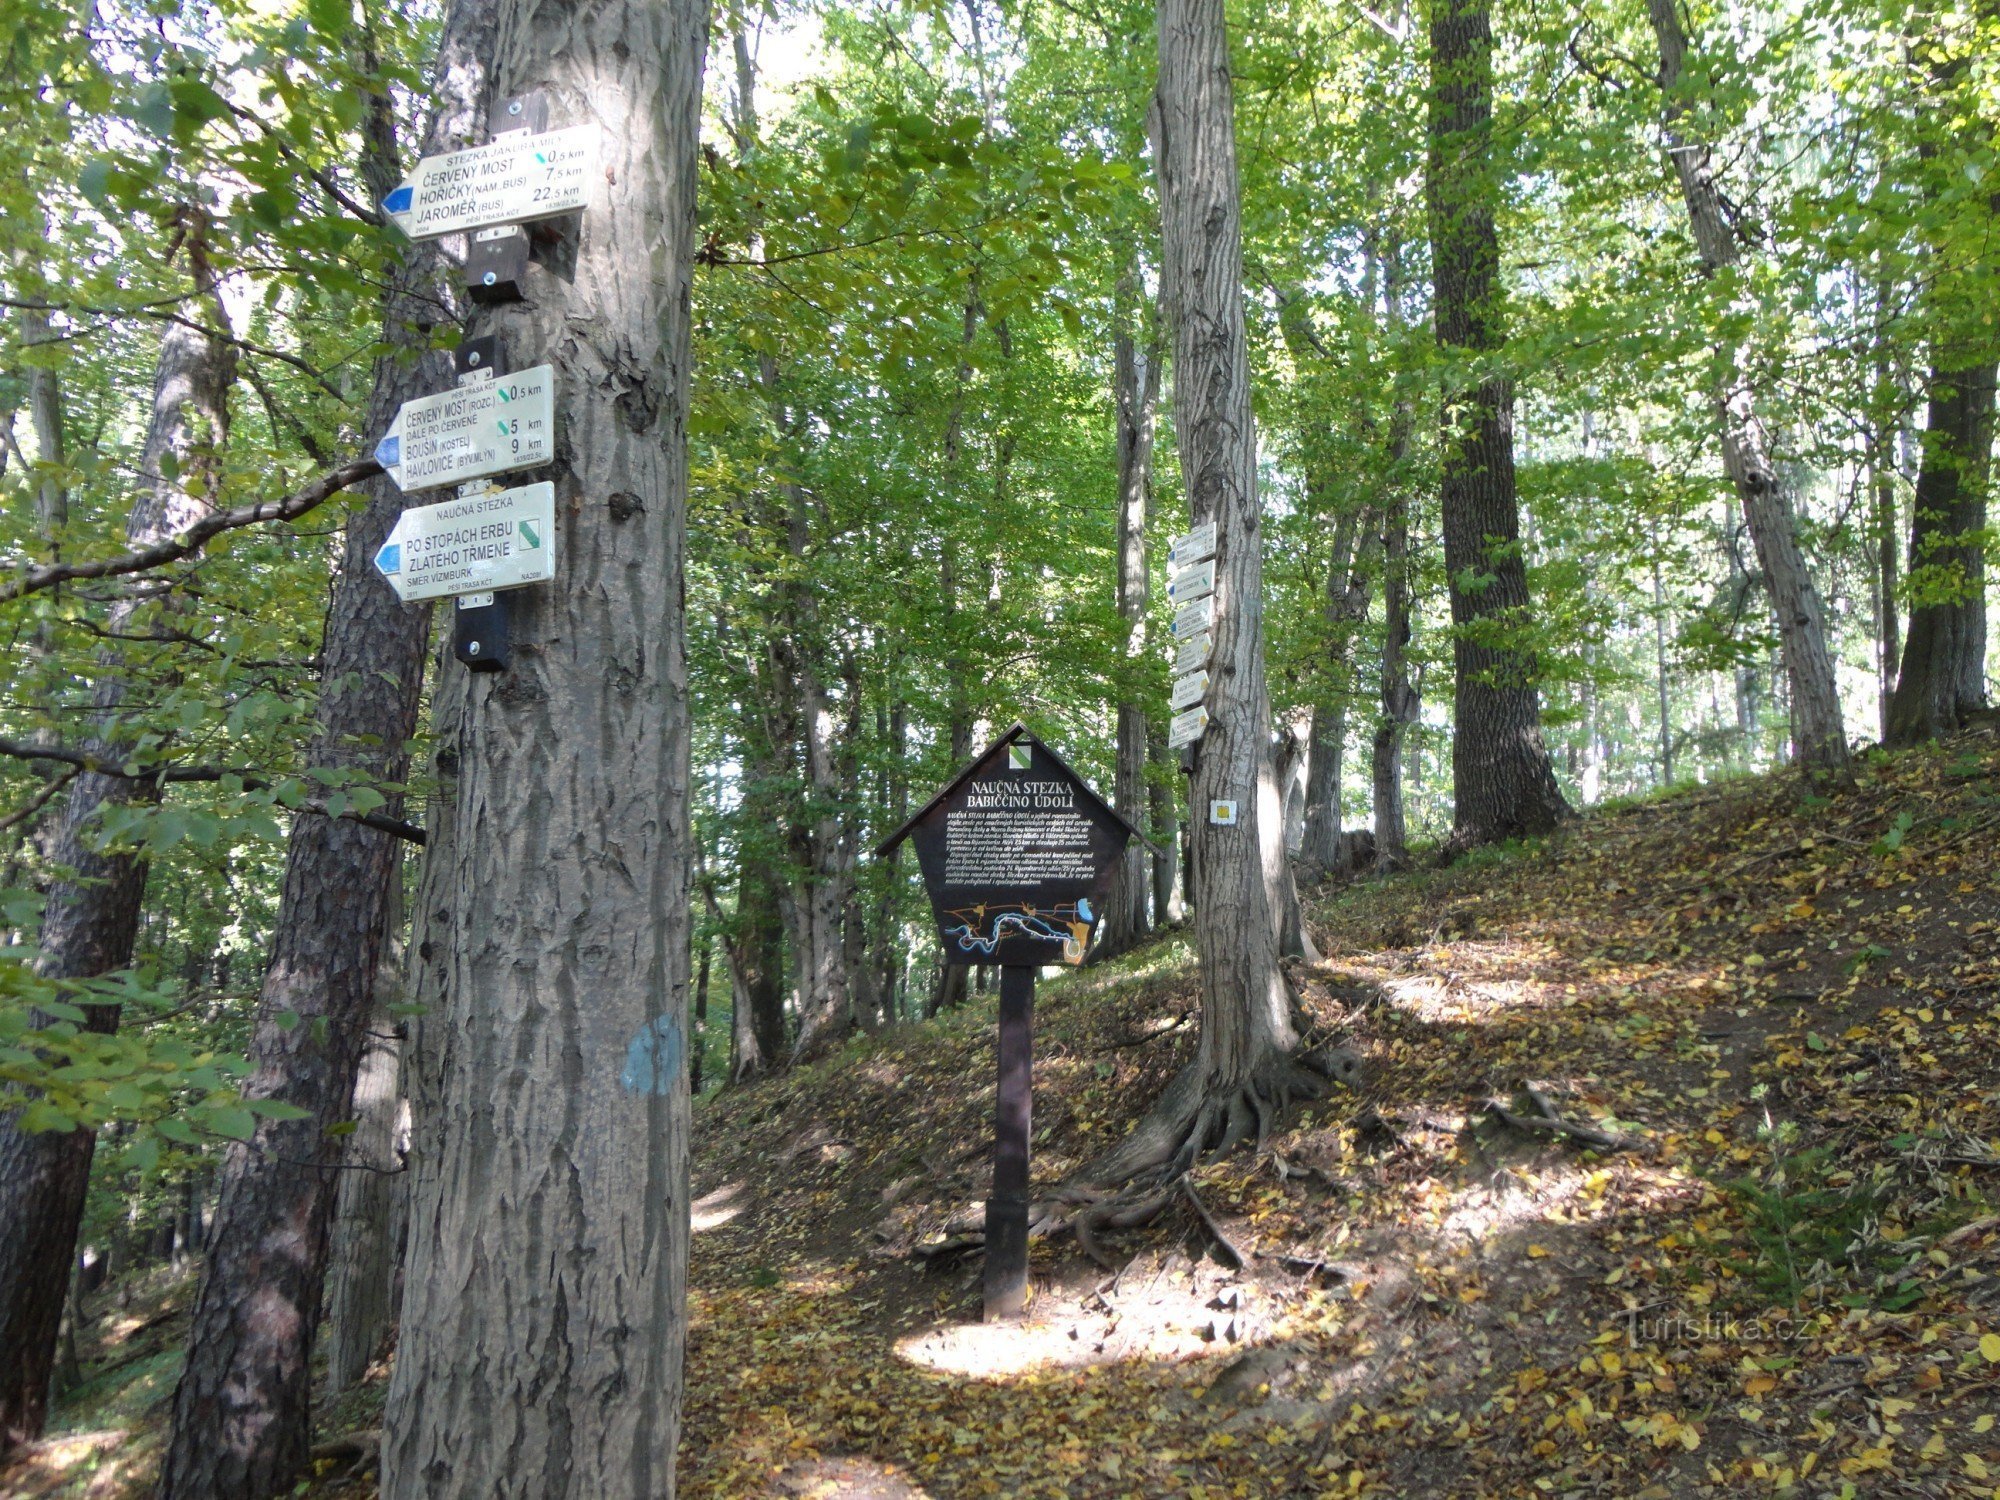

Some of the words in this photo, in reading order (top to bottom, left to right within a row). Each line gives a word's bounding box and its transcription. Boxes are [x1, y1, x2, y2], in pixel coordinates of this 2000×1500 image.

[422, 163, 478, 188] ČERVENÝ
[480, 157, 516, 176] MOST
[548, 150, 566, 164] 0,5
[568, 149, 585, 160] km
[447, 150, 488, 167] STEZKA
[419, 182, 474, 206] HOŘIČKY
[546, 167, 564, 182] 7,5
[566, 167, 582, 178] km
[416, 198, 476, 224] JAROMĚŘ
[478, 199, 504, 216] (BUS)
[563, 186, 580, 197] km
[406, 402, 442, 429] ČERVENÝ
[444, 398, 467, 419] MOST
[468, 396, 496, 414] (ROZC.)
[510, 384, 526, 401] 0,5
[528, 385, 542, 396] km
[428, 424, 440, 436] PO
[440, 412, 478, 433] ČERVENÉ
[439, 434, 471, 455] (KOSTEL)
[510, 418, 519, 435] 5
[528, 419, 542, 430] km
[406, 454, 454, 480] HAVLOVICE
[511, 438, 519, 454] 9
[528, 439, 543, 450] km
[436, 503, 475, 522] NAUČNÁ
[476, 496, 514, 514] STEZKA
[406, 538, 422, 555] PO
[424, 527, 477, 551] STOPÁCH
[480, 520, 513, 540] ERBU
[409, 550, 460, 573] ZLATÉHO
[462, 541, 511, 563] TŘMENE
[461, 580, 480, 590] TRASA
[480, 578, 493, 588] KČT
[967, 793, 1030, 808] BABIČČINO
[1034, 793, 1075, 808] ÚDOLÍ
[971, 779, 1021, 795] NAUČNÁ
[1023, 781, 1074, 795] STEZKA
